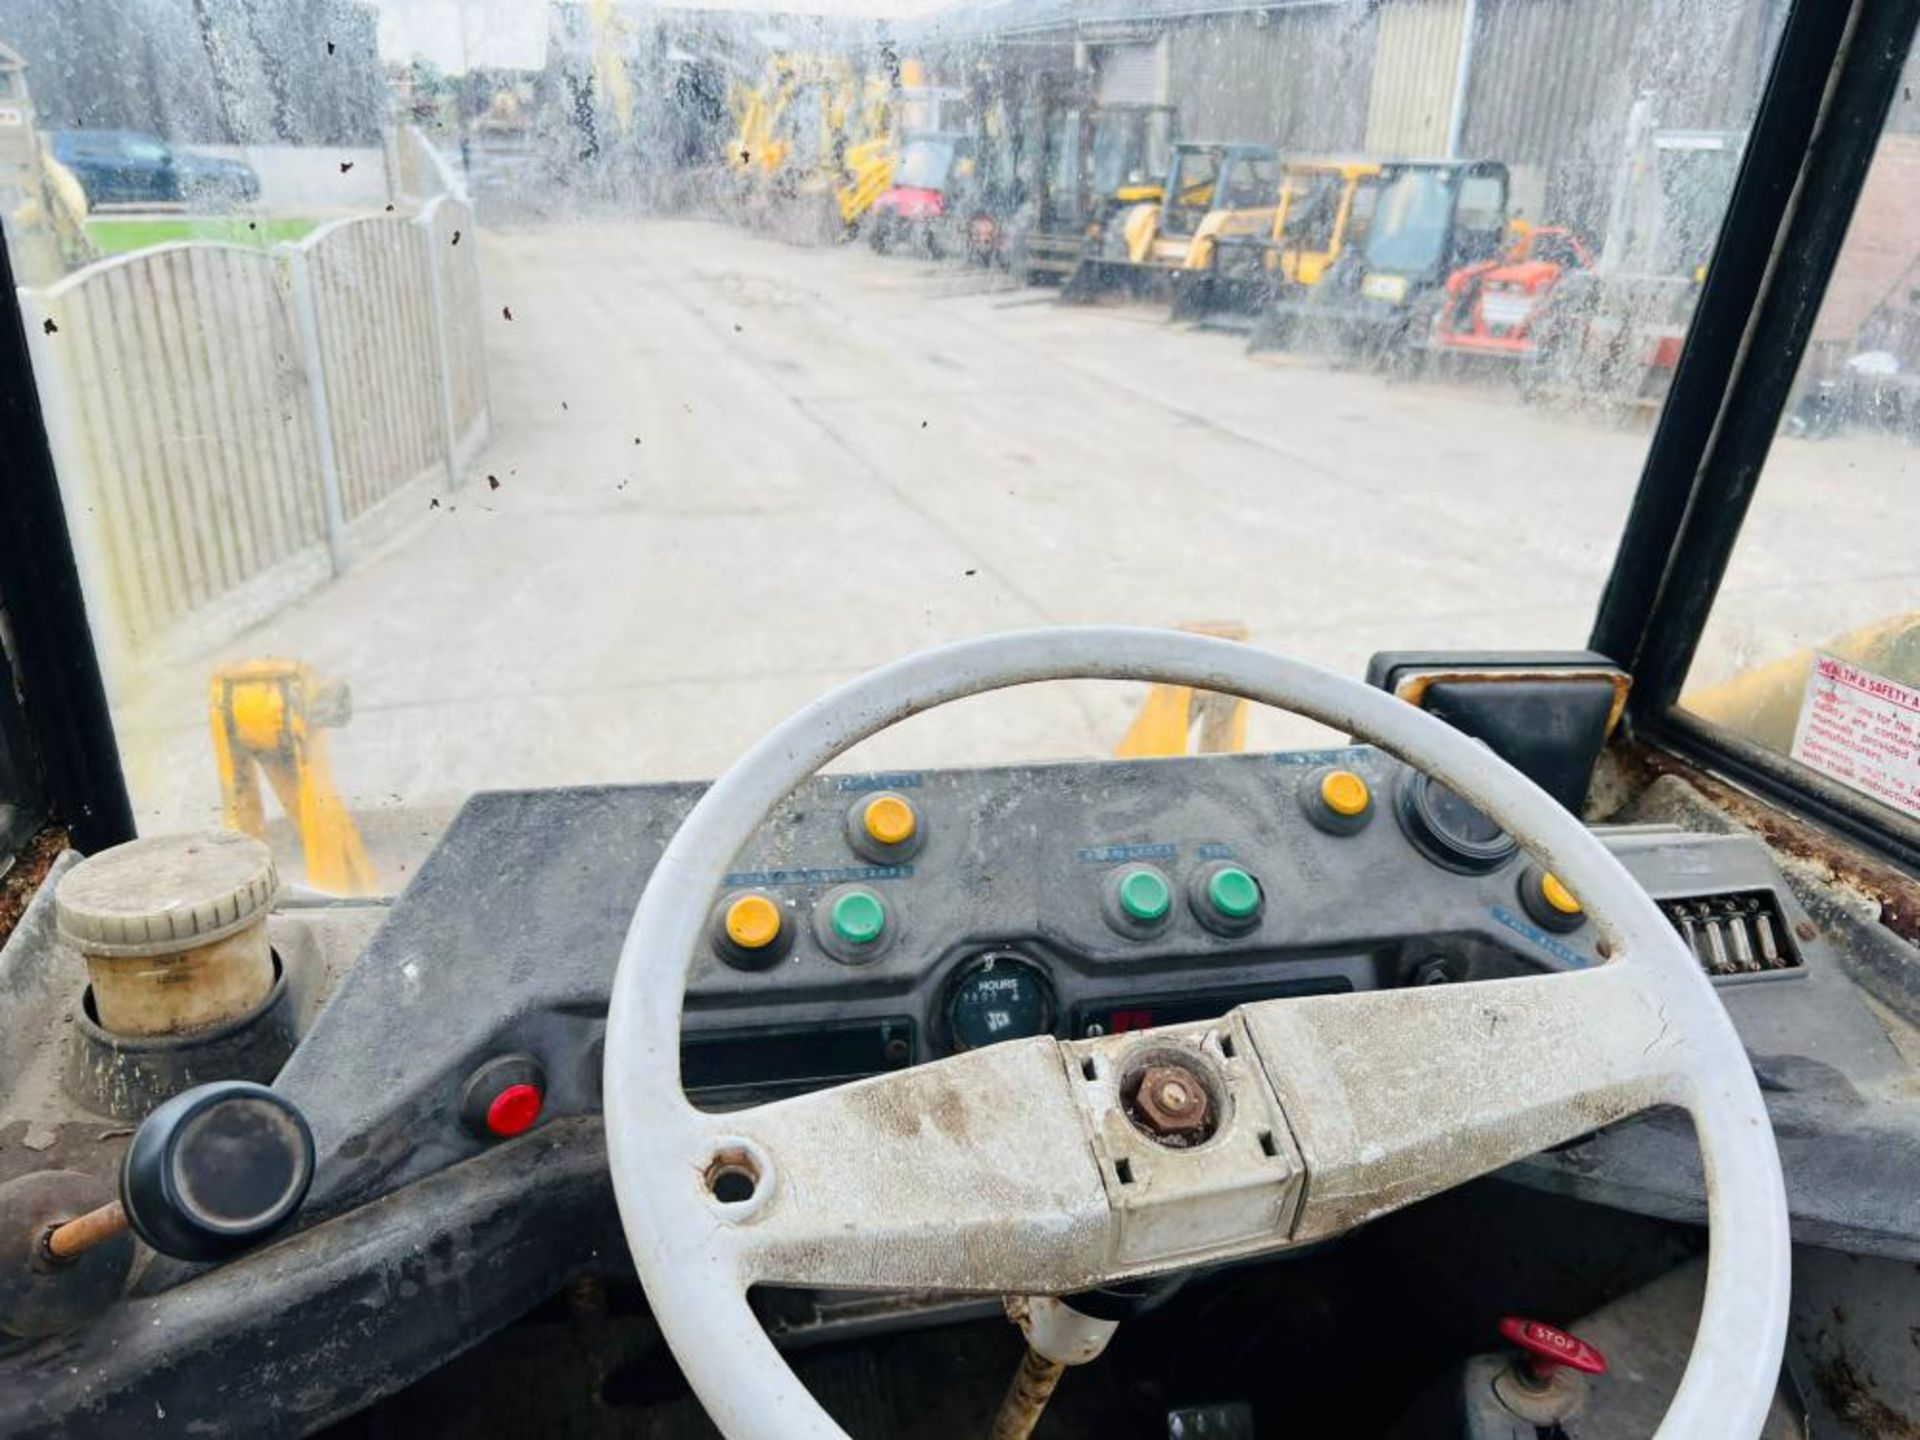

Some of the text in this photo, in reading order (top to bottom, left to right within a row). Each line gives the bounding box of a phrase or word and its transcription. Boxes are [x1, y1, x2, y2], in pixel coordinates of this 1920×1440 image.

[1819, 660, 1858, 683] HEALTH
[1858, 677, 1867, 689] &
[1869, 680, 1909, 703] SAFETY
[1895, 720, 1912, 734] the
[1861, 733, 1909, 760] provided
[979, 979, 1017, 991] HOURS
[1536, 1328, 1575, 1350] STOP
